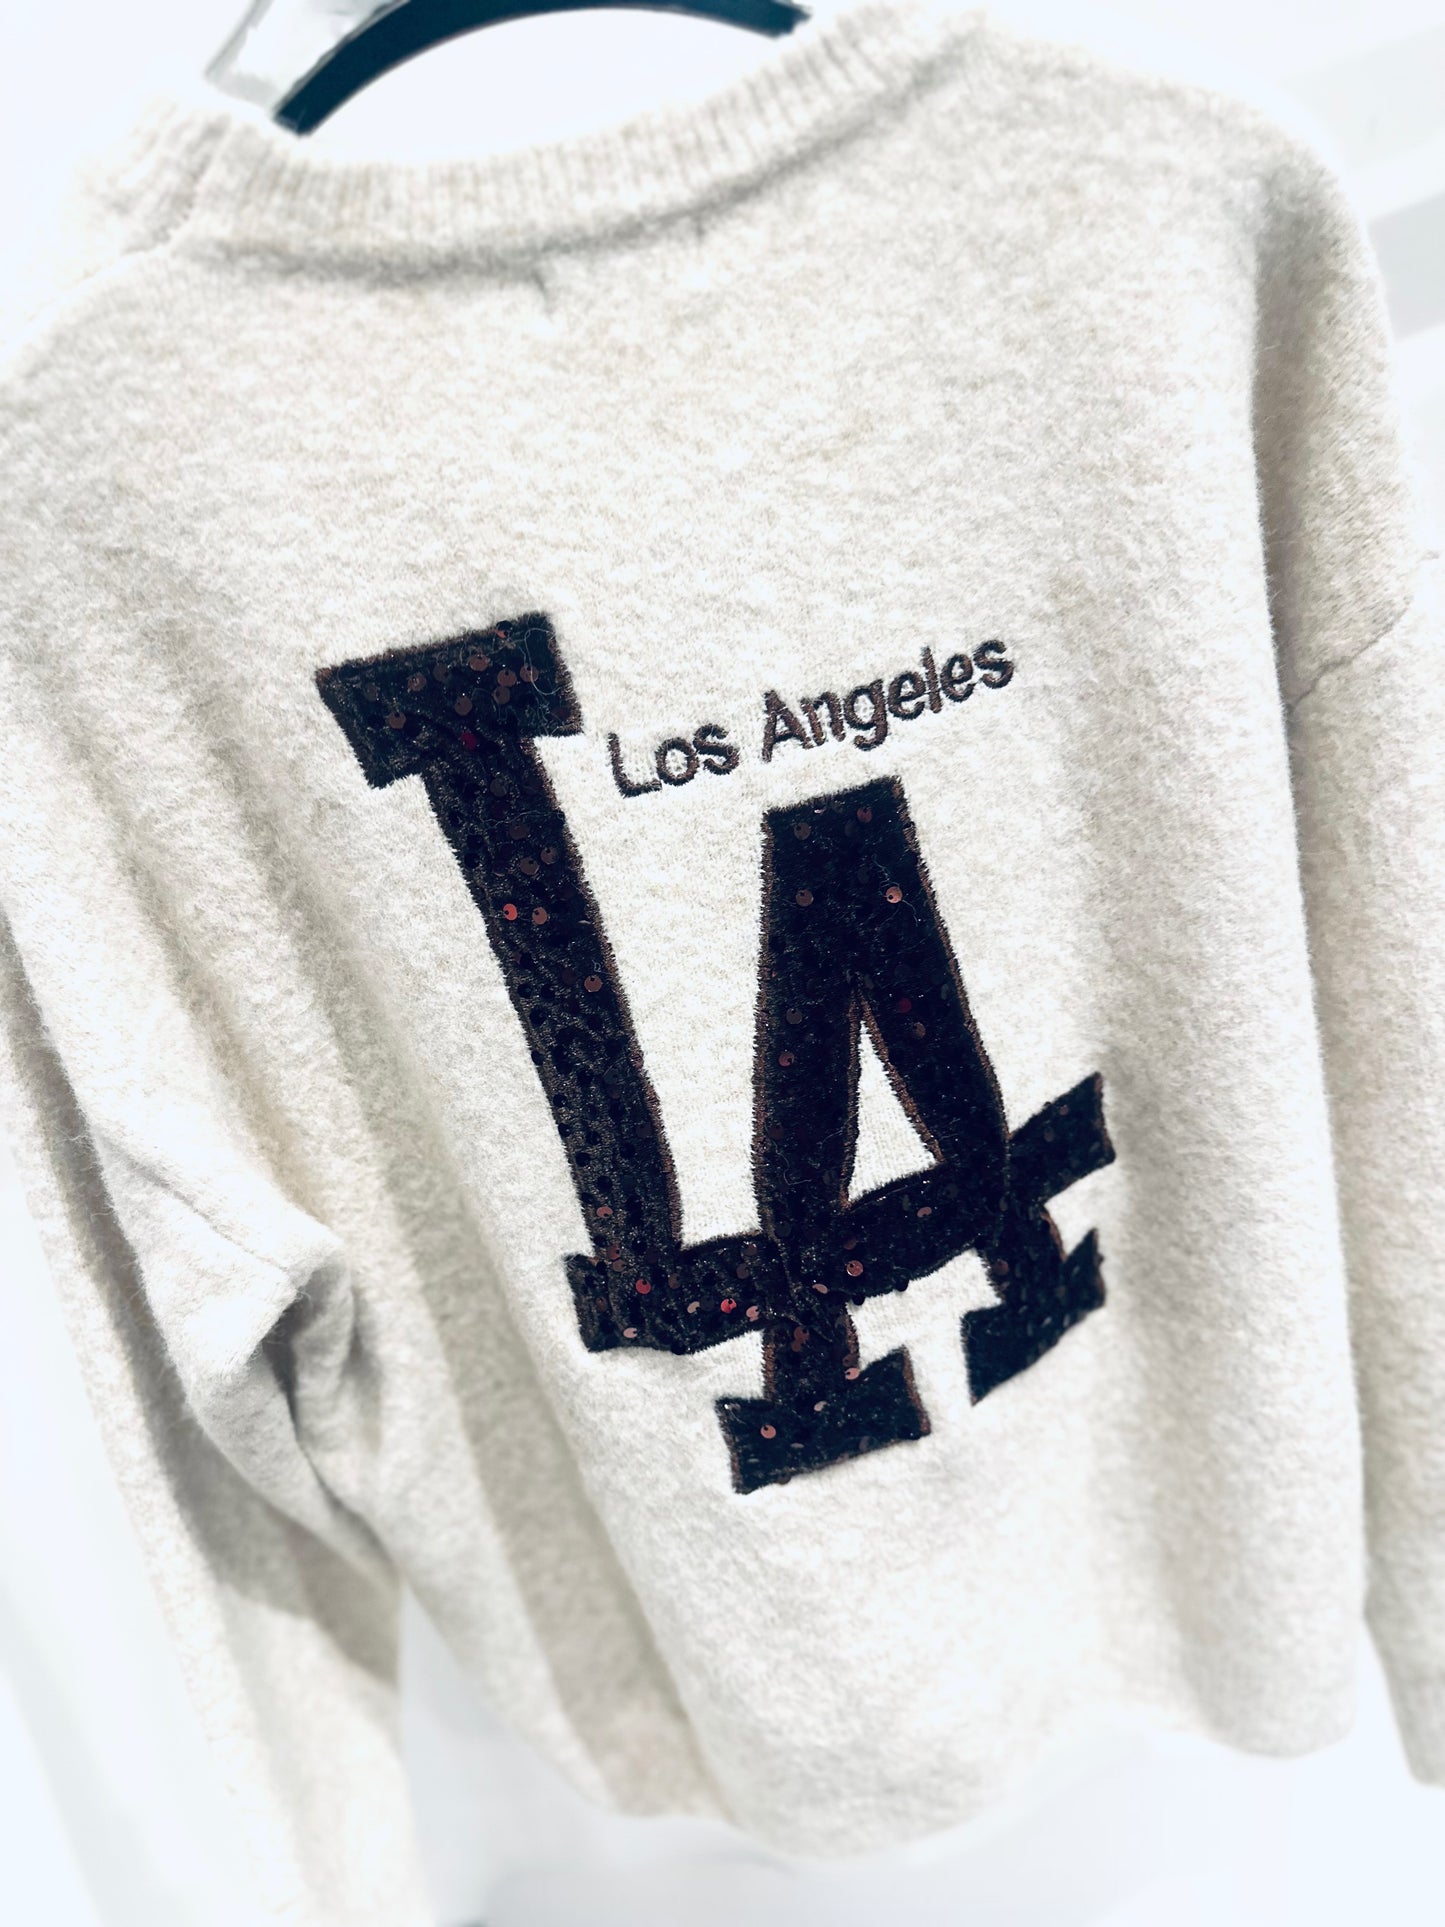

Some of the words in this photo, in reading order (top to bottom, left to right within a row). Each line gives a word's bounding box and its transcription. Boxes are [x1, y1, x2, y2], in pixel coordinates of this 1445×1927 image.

[607, 723, 740, 798] Los
[760, 639, 1015, 763] Angeles
[316, 611, 1116, 1495] LA
